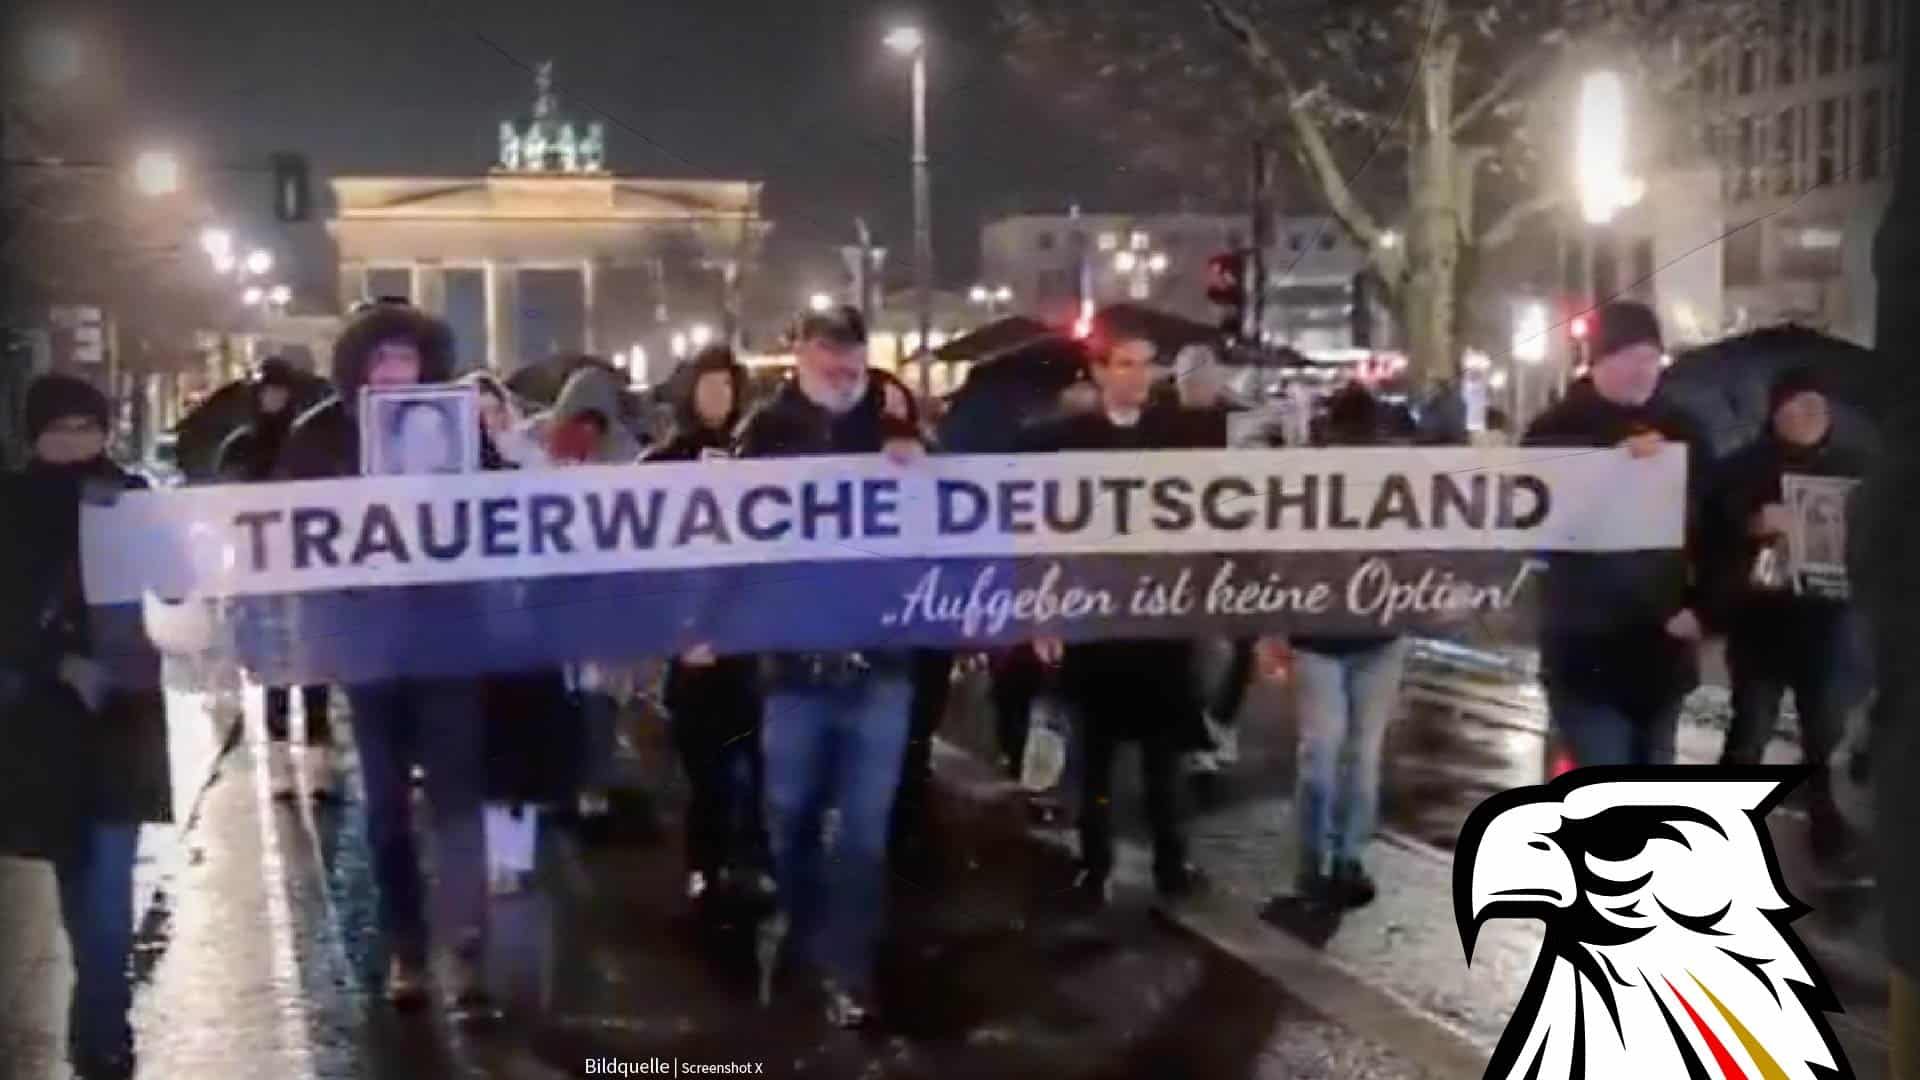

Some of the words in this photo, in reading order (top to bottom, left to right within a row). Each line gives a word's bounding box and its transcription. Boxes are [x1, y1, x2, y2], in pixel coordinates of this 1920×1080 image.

[237, 480, 900, 571] TRAUERWACHE
[937, 473, 1552, 536] DEUTSCHLAND
[1130, 555, 1188, 616] ist
[1205, 558, 1328, 614] keine
